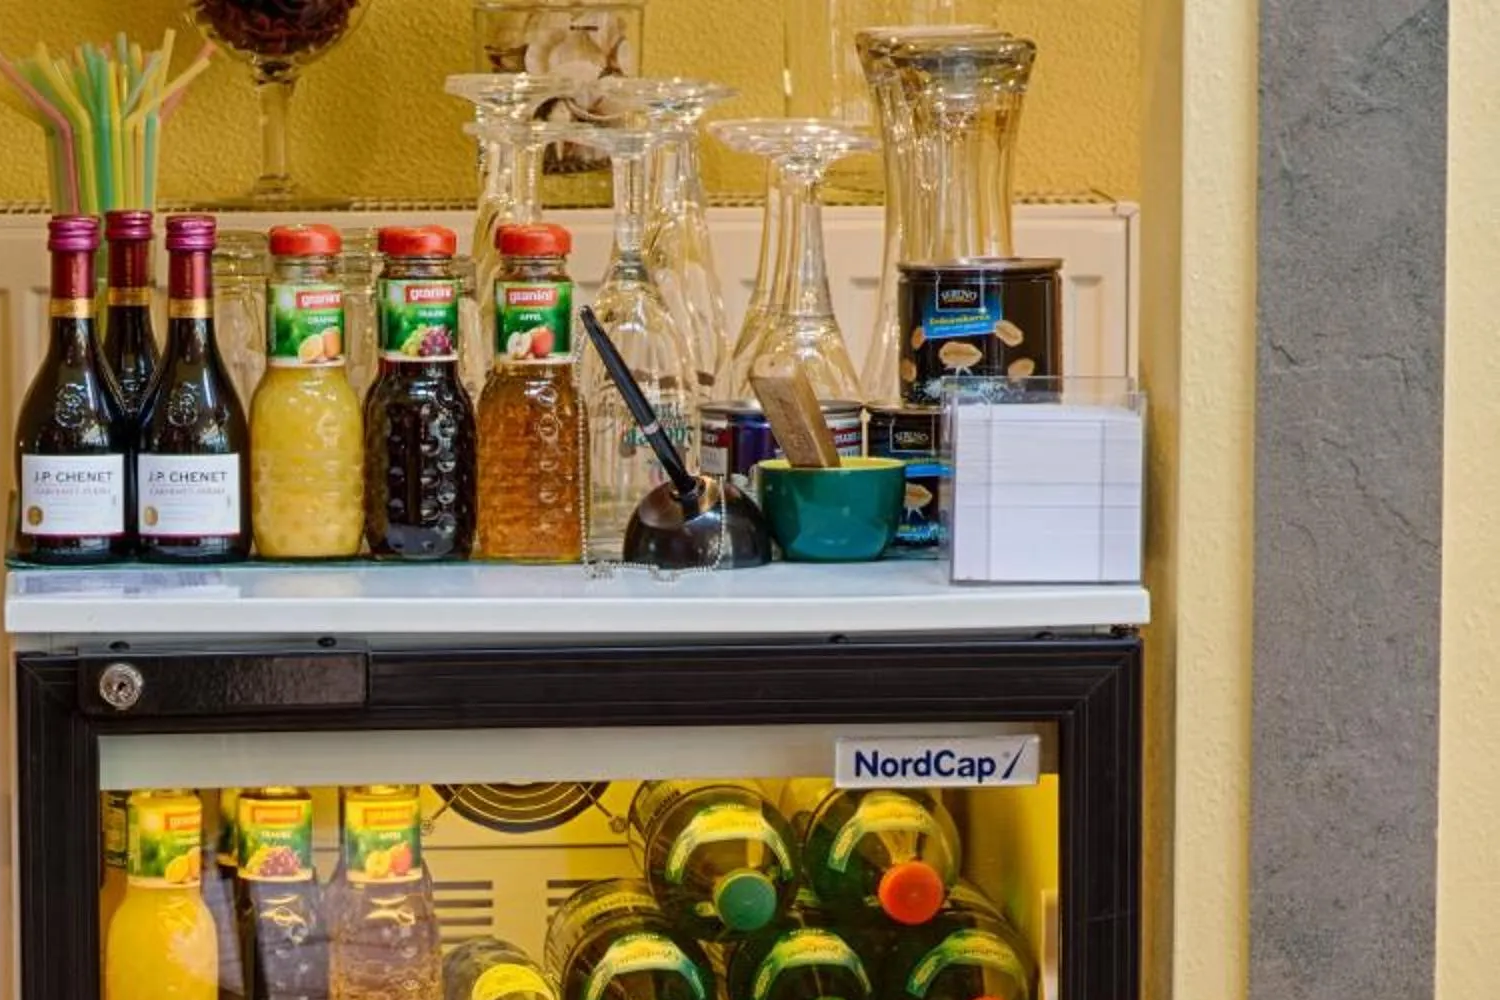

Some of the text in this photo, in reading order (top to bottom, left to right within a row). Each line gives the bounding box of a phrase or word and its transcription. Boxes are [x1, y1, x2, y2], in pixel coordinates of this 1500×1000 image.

[55, 471, 113, 484] CHENET
[169, 471, 228, 484] CHENET
[854, 749, 997, 784] NordCap
